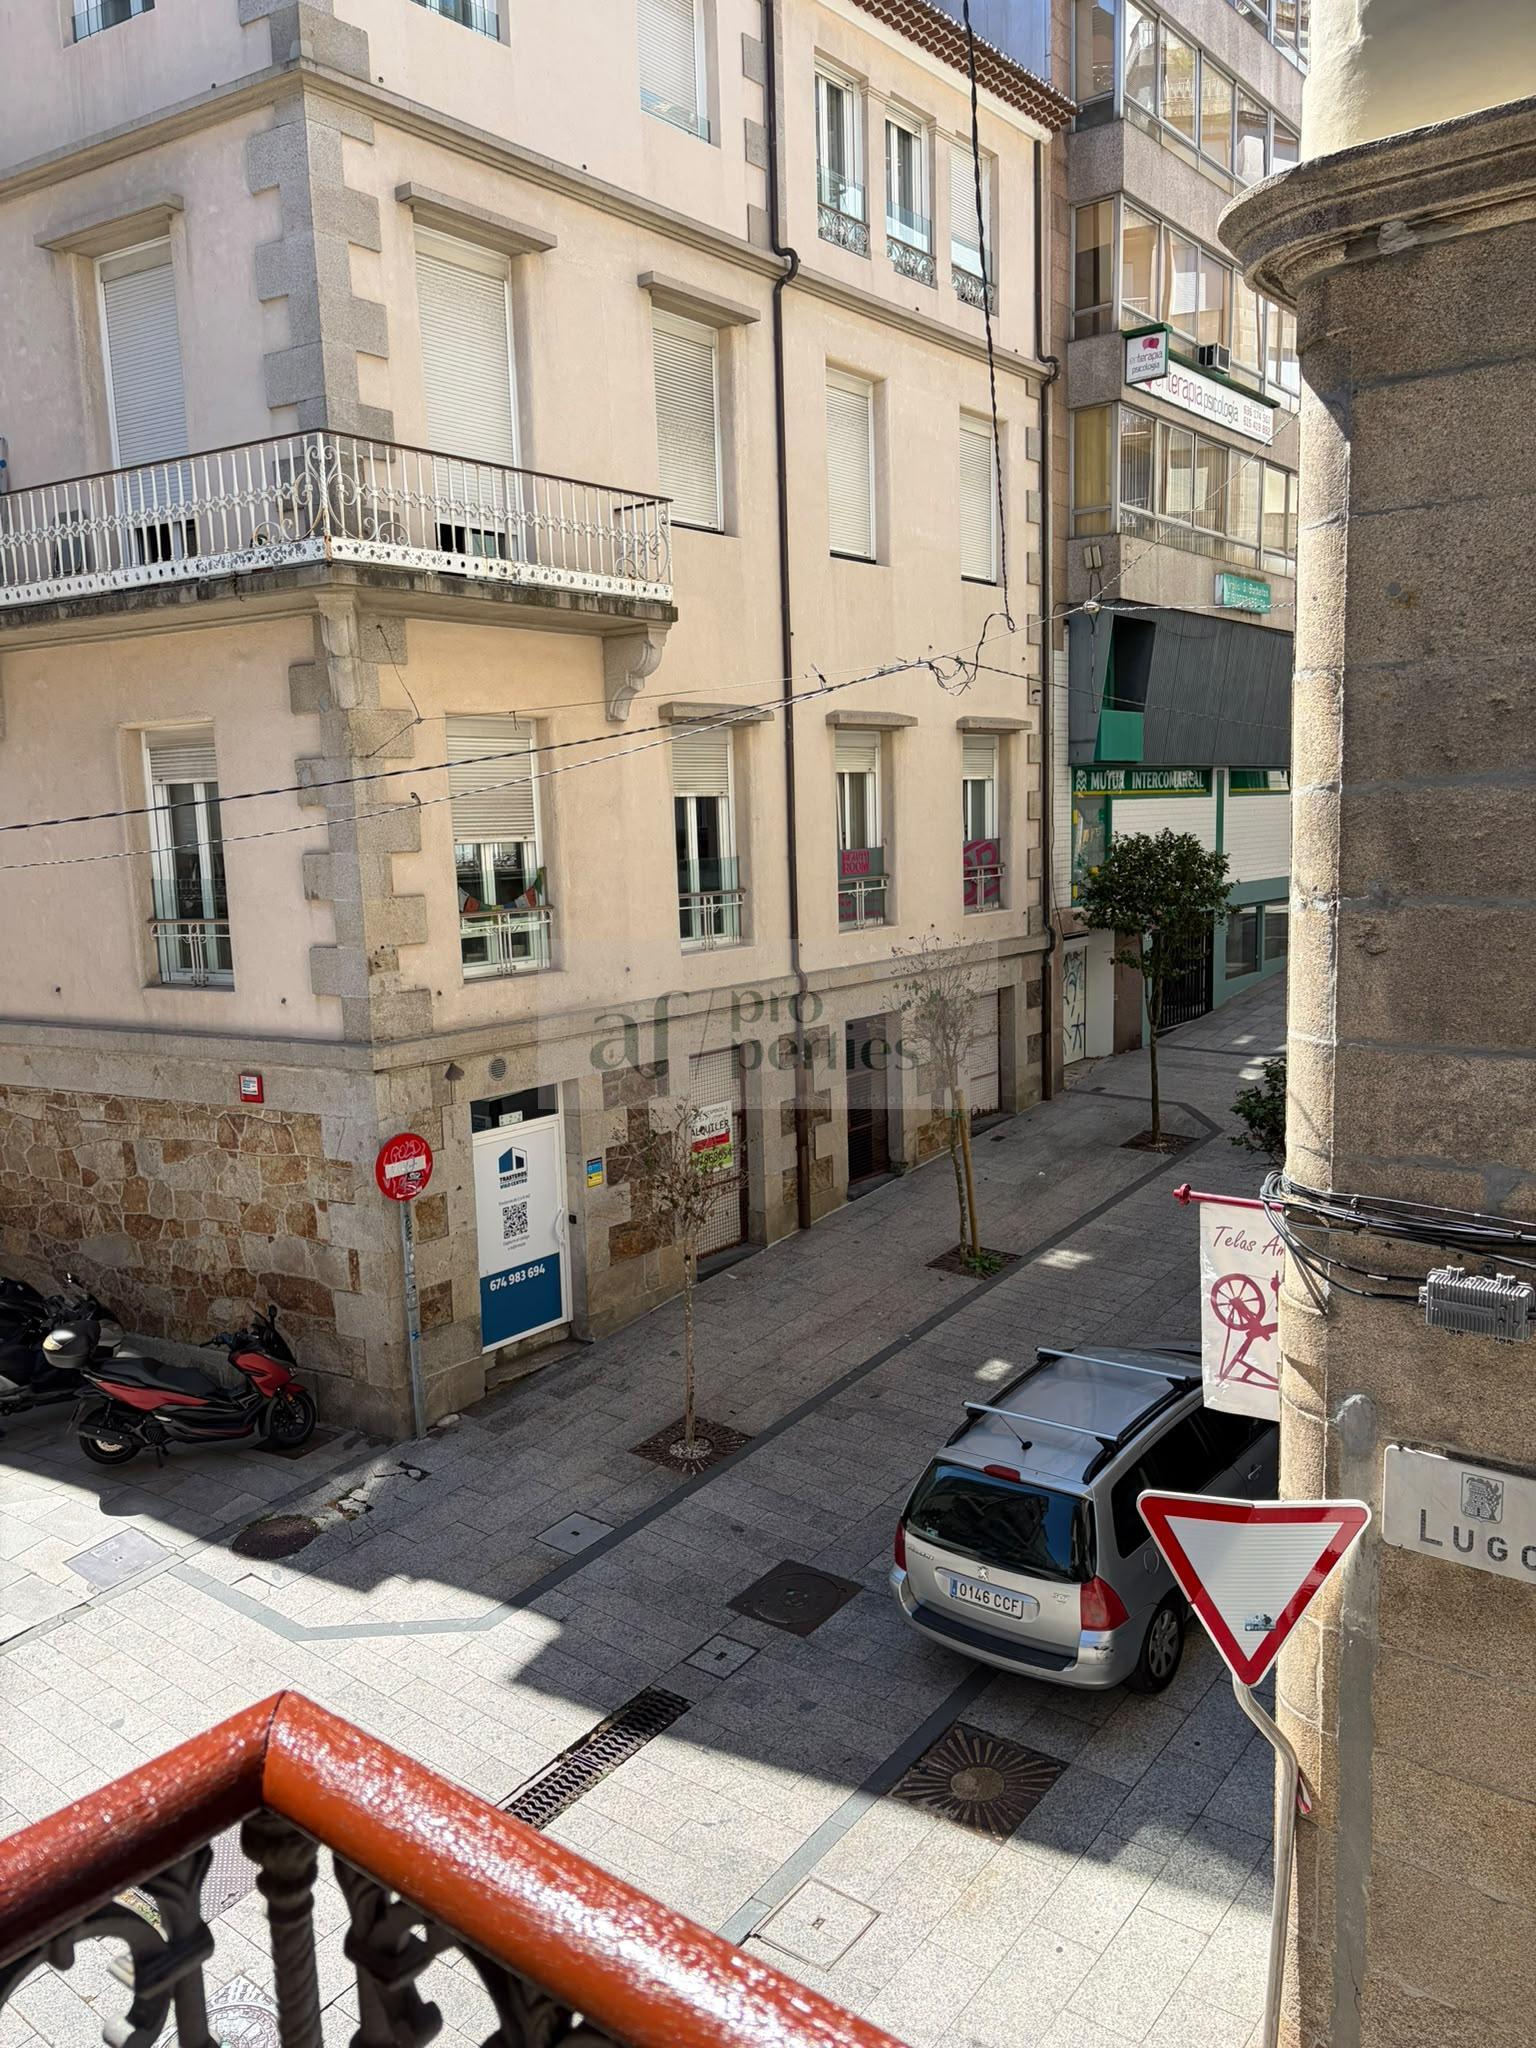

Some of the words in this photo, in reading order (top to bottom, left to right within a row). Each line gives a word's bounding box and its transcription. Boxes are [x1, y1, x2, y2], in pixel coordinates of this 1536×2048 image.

[1132, 770, 1205, 790] INTERCOMARCAL
[691, 1120, 730, 1137] ALQUILER
[499, 1171, 528, 1183] TRASTEROS
[1213, 1226, 1257, 1252] Telas
[489, 1276, 508, 1292] 674
[508, 1269, 526, 1285] 983
[527, 1263, 546, 1278] 694
[1419, 1508, 1536, 1571] LUGO
[959, 1583, 990, 1604] 0146
[993, 1593, 1019, 1612] CCF
